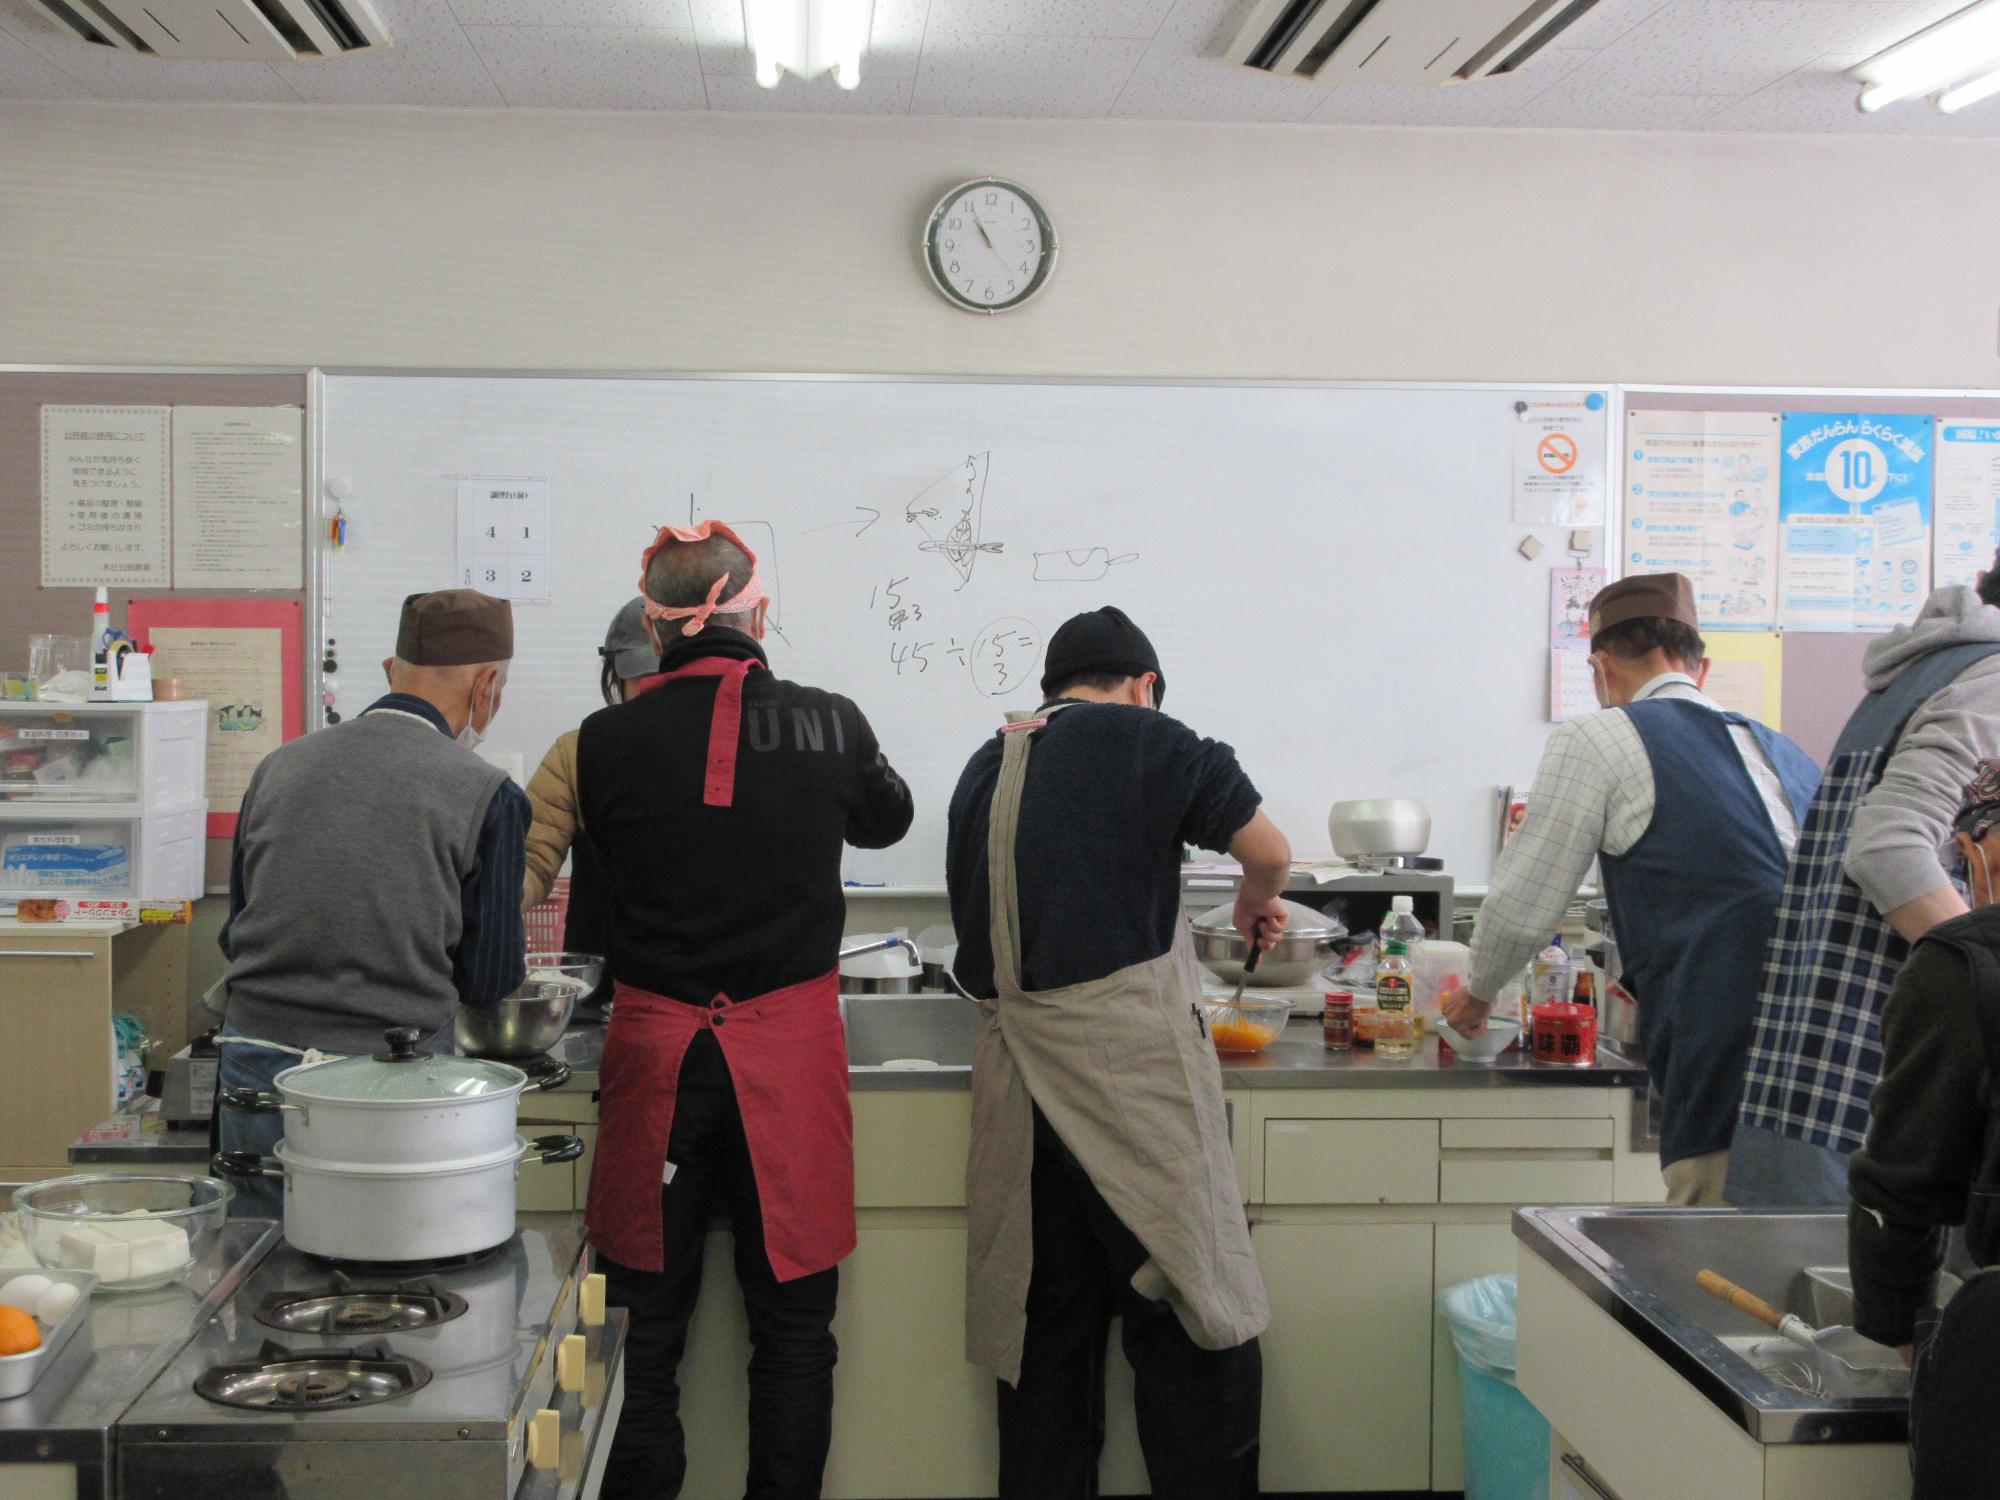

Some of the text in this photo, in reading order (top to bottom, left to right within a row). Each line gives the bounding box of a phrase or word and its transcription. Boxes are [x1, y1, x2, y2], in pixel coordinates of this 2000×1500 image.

[985, 193, 998, 206] 12
[964, 200, 974, 213] 11
[949, 218, 962, 230] 10
[1022, 218, 1031, 231] 2
[944, 239, 955, 253] 9
[1025, 240, 1035, 253] 3
[949, 261, 960, 273] 8
[1019, 261, 1029, 274] 4
[965, 279, 974, 293] 7
[984, 284, 994, 299] 6
[1007, 280, 1016, 294] 5
[1839, 450, 1872, 489] 10
[486, 526, 530, 539] 4 1
[485, 569, 532, 582] 3 2
[870, 576, 909, 609] 15
[890, 642, 935, 675] 45
